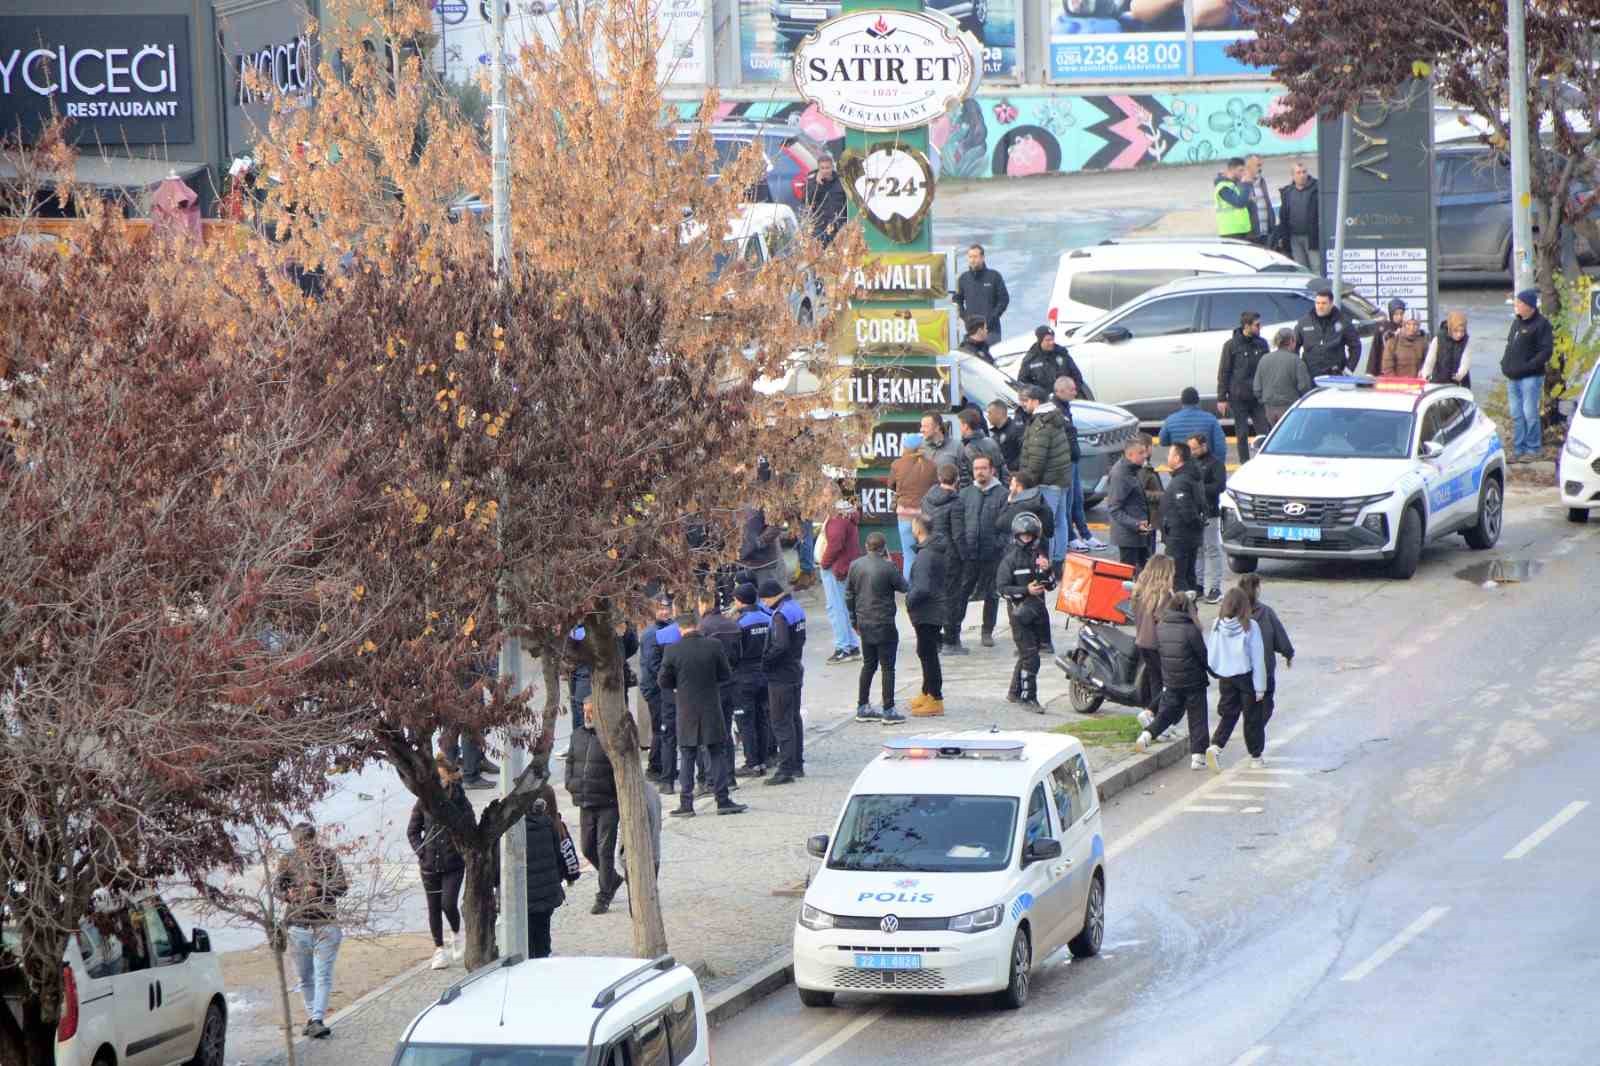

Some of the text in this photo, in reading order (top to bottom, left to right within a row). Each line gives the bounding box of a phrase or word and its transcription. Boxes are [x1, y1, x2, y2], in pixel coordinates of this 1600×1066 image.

[854, 44, 911, 54] TRAKYA
[1083, 45, 1119, 65] 236
[1124, 44, 1150, 64] 48
[1154, 43, 1182, 63] 00
[809, 57, 956, 84] SATIR ET
[67, 101, 178, 117] RESTAURANT
[839, 103, 928, 121] RESTAURANT
[865, 176, 918, 197] 7-24
[878, 378, 945, 403] EKMEK
